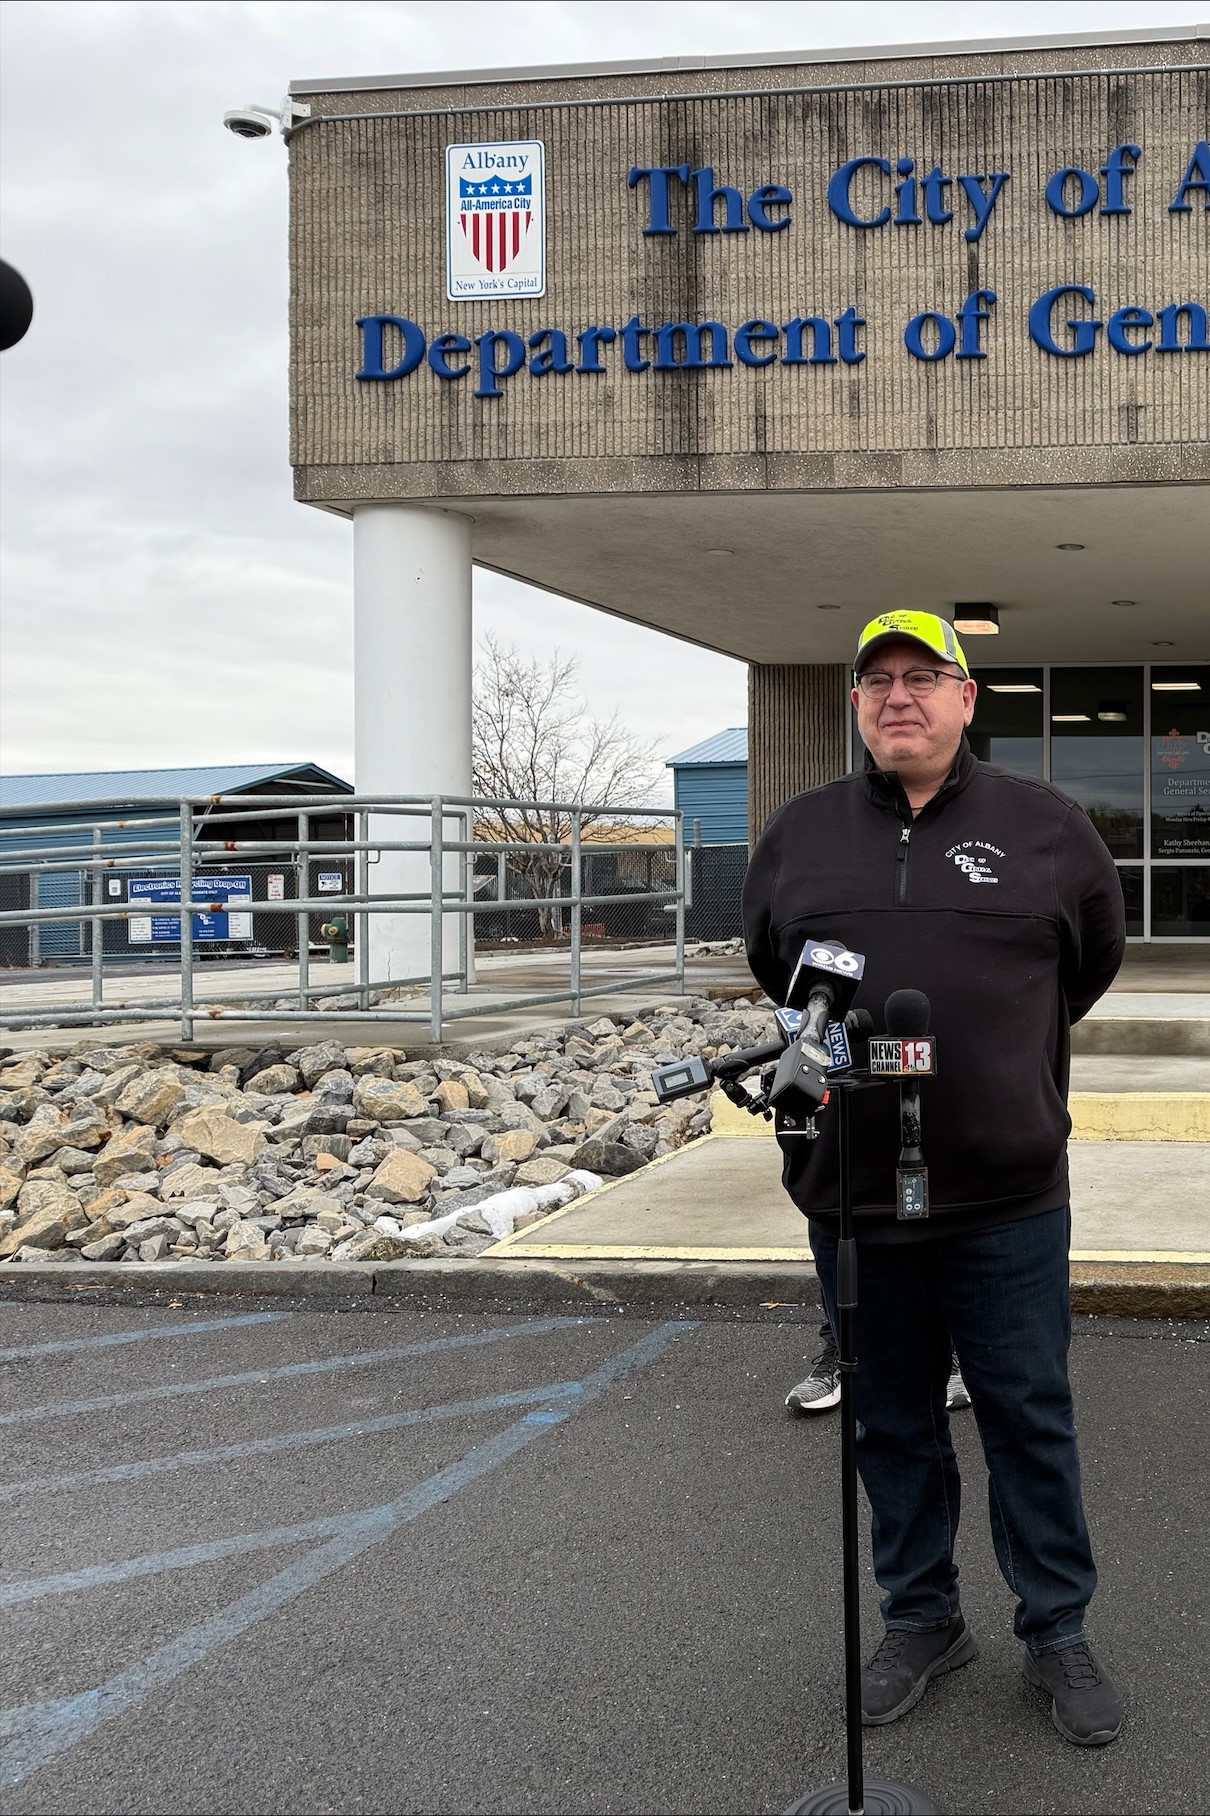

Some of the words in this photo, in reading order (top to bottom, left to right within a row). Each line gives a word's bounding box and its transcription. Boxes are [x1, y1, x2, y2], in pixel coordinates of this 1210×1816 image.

[461, 151, 529, 173] Albany
[629, 163, 793, 235] The
[828, 157, 1010, 243] City
[1046, 144, 1141, 218] of
[460, 198, 512, 211] All-America
[514, 197, 531, 210] City
[455, 279, 475, 291] New
[478, 278, 504, 289] York's
[507, 276, 538, 291] Capital
[356, 307, 866, 398] Department
[904, 289, 997, 361] of
[1163, 786, 1196, 795] General
[944, 844, 961, 858] CITY
[962, 840, 973, 848] OF
[975, 840, 1006, 858] ALBANY
[1164, 839, 1182, 847] Kathy
[1183, 839, 1210, 847] Sheehan,
[132, 881, 176, 893] Electronics
[834, 951, 859, 972] 6
[833, 967, 854, 977] NEWS
[828, 1023, 847, 1065] NEWS
[871, 1042, 902, 1060] NEWS
[904, 1041, 931, 1071] 13
[871, 1061, 902, 1073] CHANNEL
